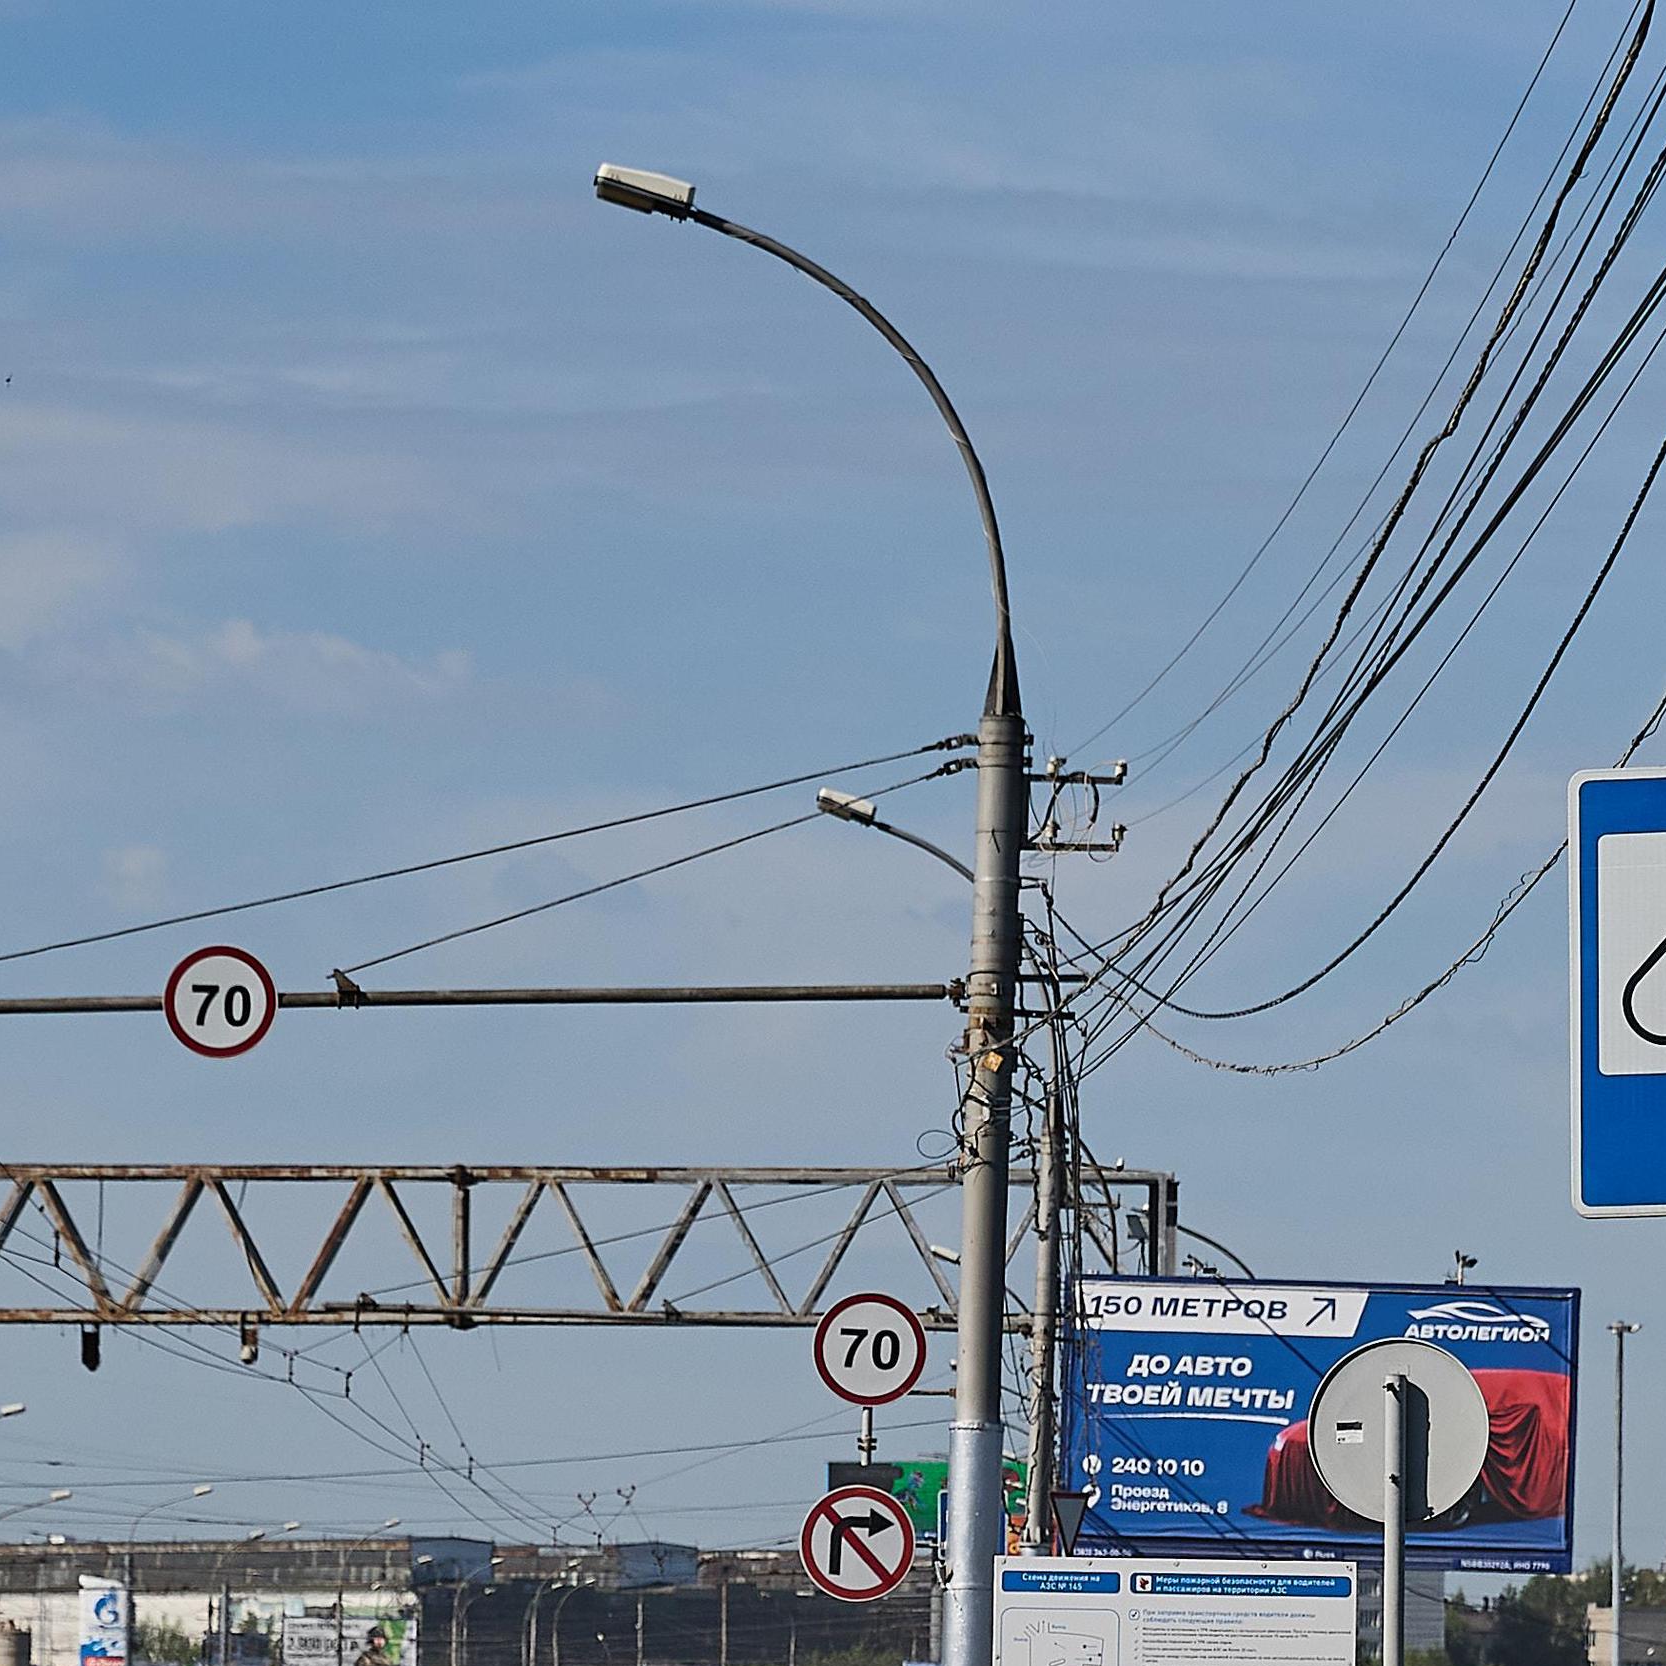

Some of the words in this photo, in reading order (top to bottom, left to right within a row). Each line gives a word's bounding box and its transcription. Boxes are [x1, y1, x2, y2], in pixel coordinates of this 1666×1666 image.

[191, 984, 252, 1028] 70
[1090, 1295, 1142, 1315] 150
[1151, 1296, 1289, 1320] МЕТРОВ
[1404, 1324, 1551, 1343] АВТОЛЕГИОН
[840, 1327, 901, 1371] 70
[1126, 1354, 1171, 1378] ДО
[1174, 1354, 1253, 1378] АВТО
[1086, 1381, 1183, 1406] ТВОЕЙ
[1186, 1388, 1296, 1411] МЕЧТЫ
[1111, 1457, 1150, 1475] 240
[1156, 1457, 1178, 1476] 10
[1180, 1458, 1205, 1477] 10
[1111, 1484, 1170, 1501] Проезд
[1110, 1499, 1215, 1516] Энергетиков,
[1216, 1500, 1228, 1515] 8
[1022, 1572, 1047, 1582] Схема
[1048, 1573, 1089, 1583] движения
[1039, 1582, 1057, 1591] АЗС
[1057, 1582, 1067, 1591] №
[1155, 1576, 1179, 1587] Меры
[1180, 1576, 1219, 1587] пожарной
[1221, 1577, 1276, 1588] безопасности
[1277, 1578, 1291, 1587] для
[1293, 1578, 1336, 1588] водителей
[1162, 1586, 1211, 1594] пассажиров
[1224, 1587, 1270, 1595] территории
[1271, 1587, 1287, 1595] АЗС
